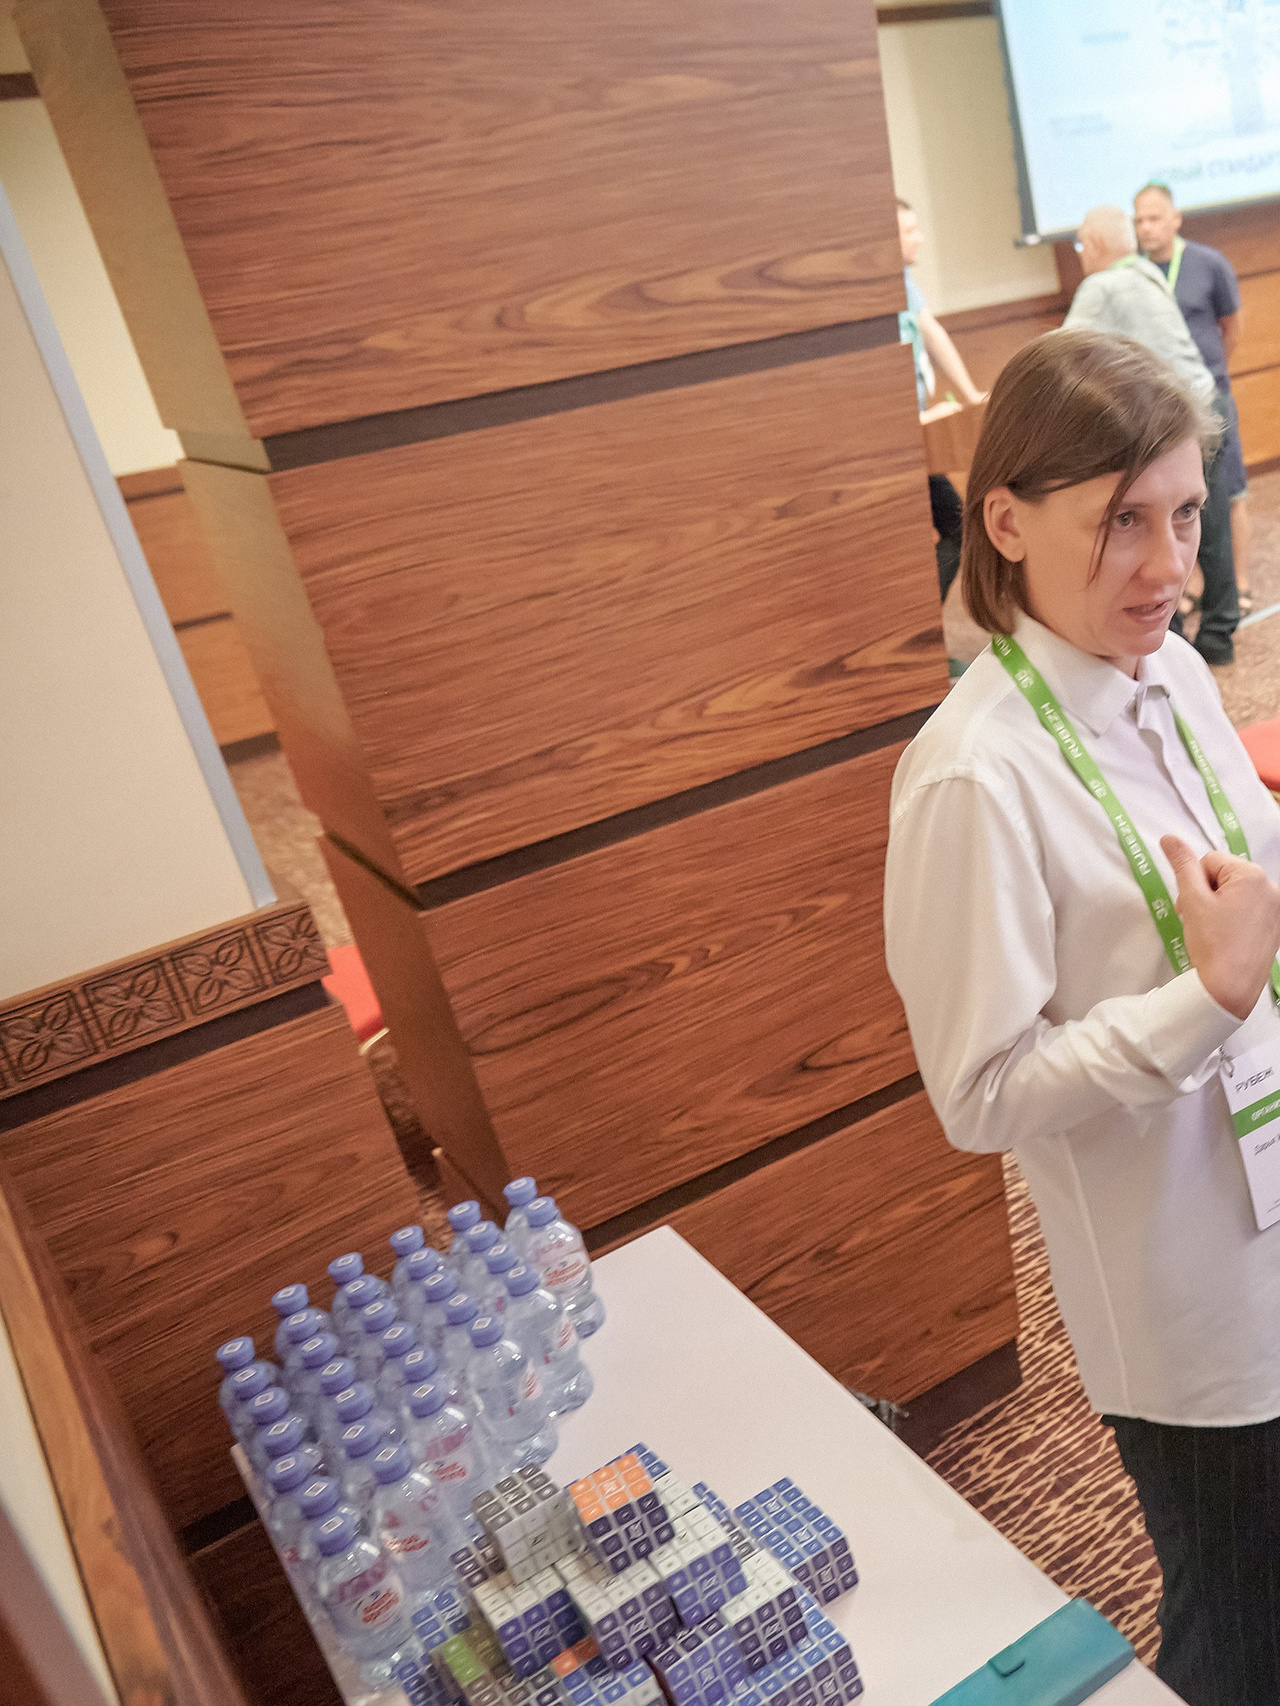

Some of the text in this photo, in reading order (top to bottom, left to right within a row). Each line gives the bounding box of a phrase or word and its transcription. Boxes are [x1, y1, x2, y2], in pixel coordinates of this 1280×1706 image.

[1040, 701, 1082, 759] RUBEZH
[1114, 814, 1151, 876] RUBEZH
[1235, 1066, 1275, 1092] РУБЕЖ
